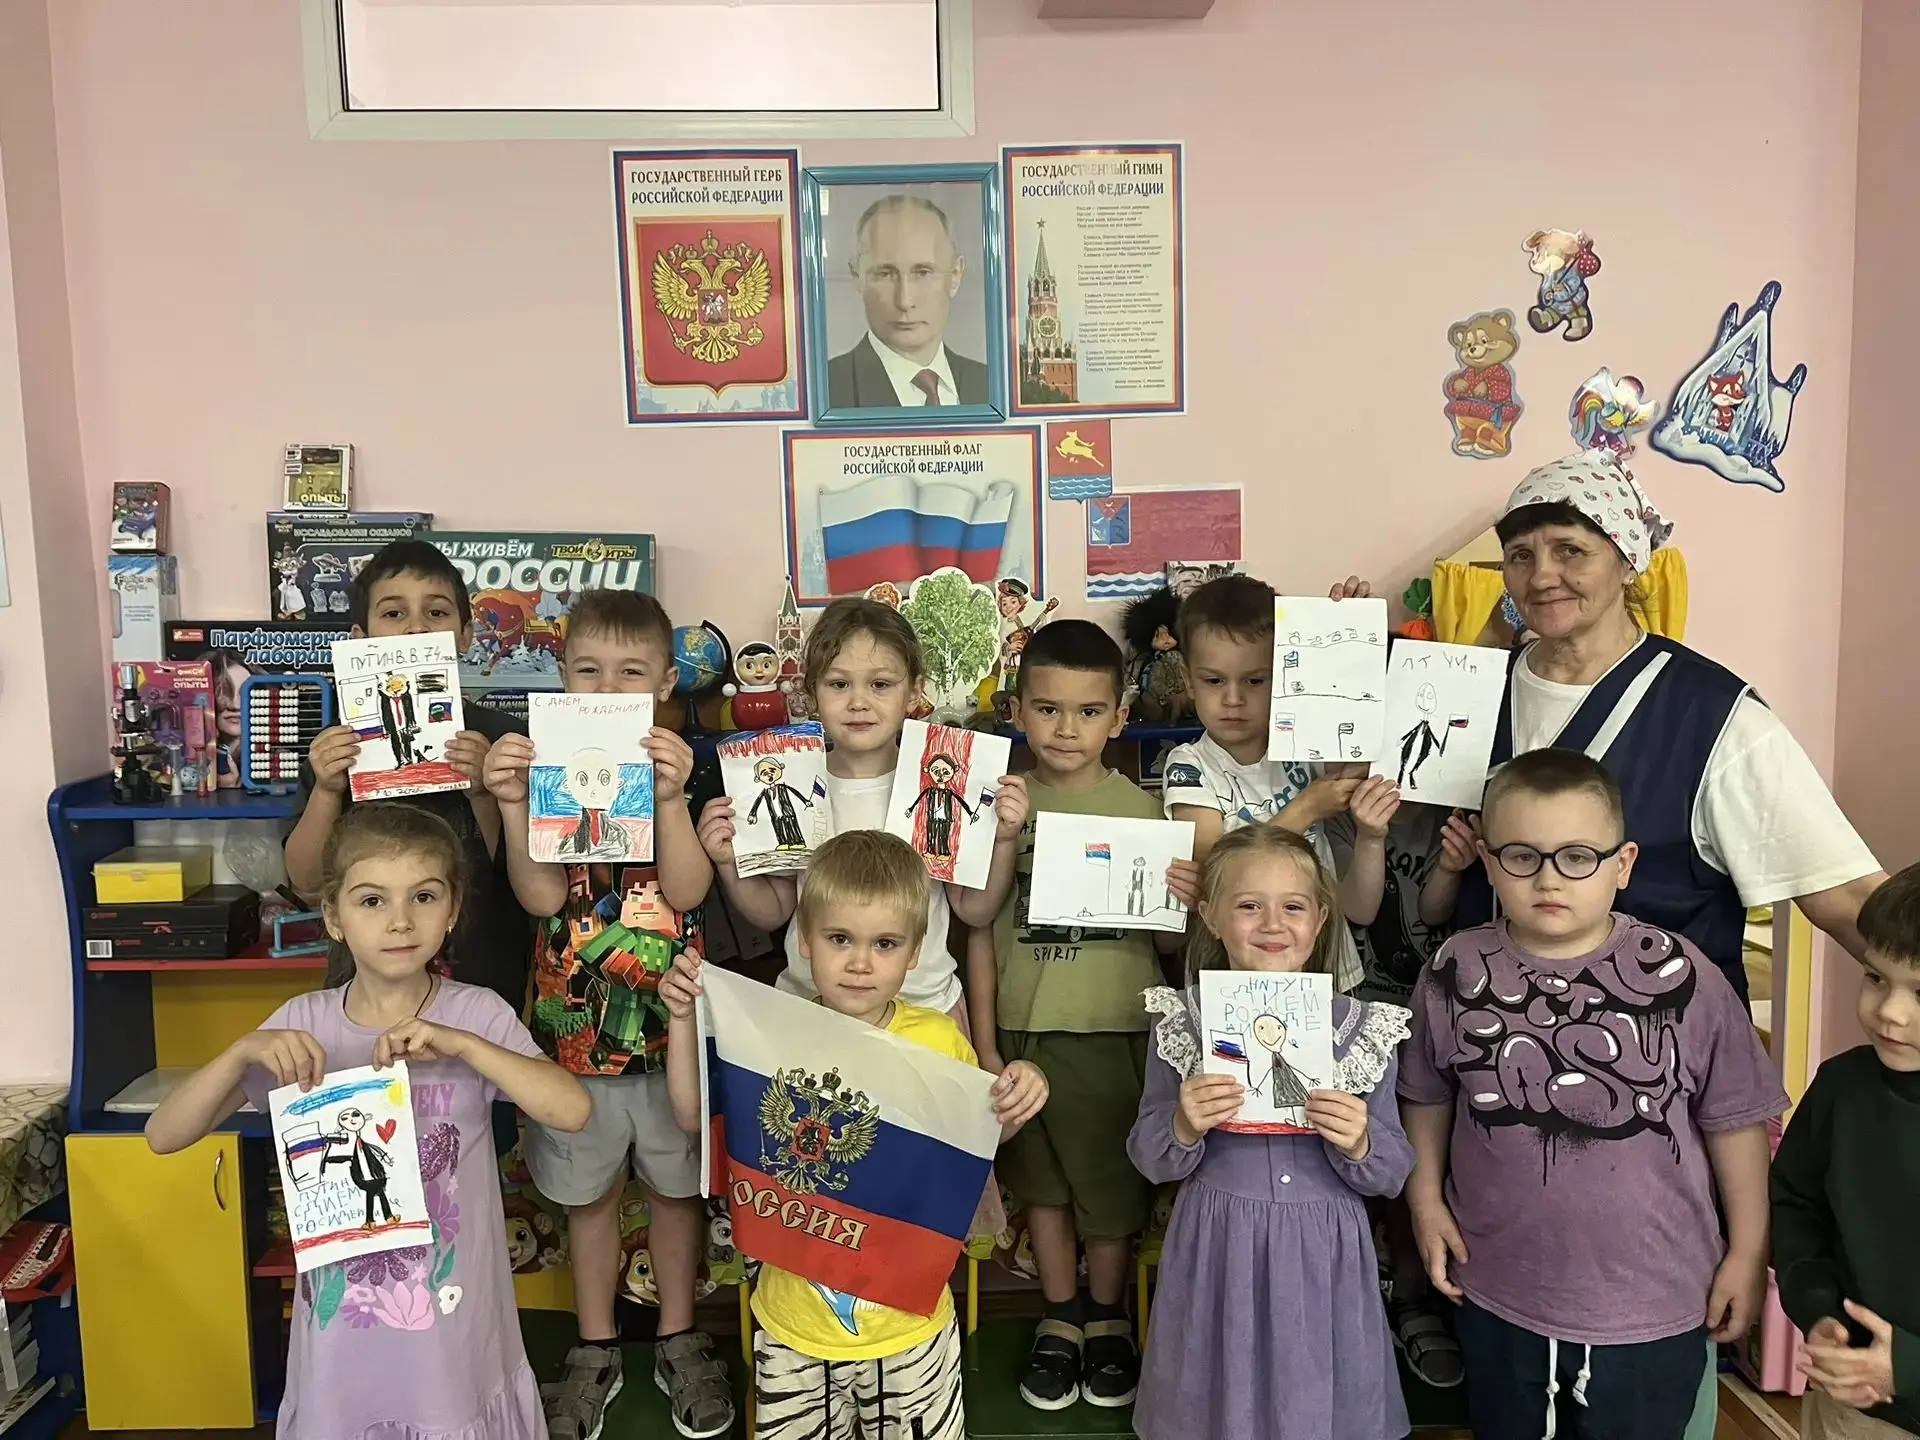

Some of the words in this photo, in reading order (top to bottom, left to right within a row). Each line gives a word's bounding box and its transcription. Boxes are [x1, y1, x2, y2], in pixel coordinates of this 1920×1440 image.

[631, 165, 750, 185] ГОСУДАРСТВЕННЫЙ
[753, 169, 782, 183] ГЕРБ
[1133, 163, 1163, 175] ГИМН
[631, 187, 710, 204] РОССИЙСКОЙ
[712, 189, 783, 205] ФЕДЕРАЦИИ
[1022, 180, 1095, 197] РОССИЙСКОЙ
[1097, 182, 1164, 197] ФЕДЕРАЦИИ
[843, 441, 951, 458] ГОСУДАРСТВЕННЫЙ
[953, 443, 982, 456] ФЛАГ
[843, 459, 916, 475] РОССИЙСКОЙ
[918, 460, 984, 475] ФЕДЕРАЦИИ
[459, 538, 535, 557] ЖИВЁМ
[210, 627, 349, 652] Парфюмерна
[245, 647, 333, 669] лаборат
[1033, 946, 1082, 962] SPIRIT
[727, 1172, 869, 1251] ОССИЯ
